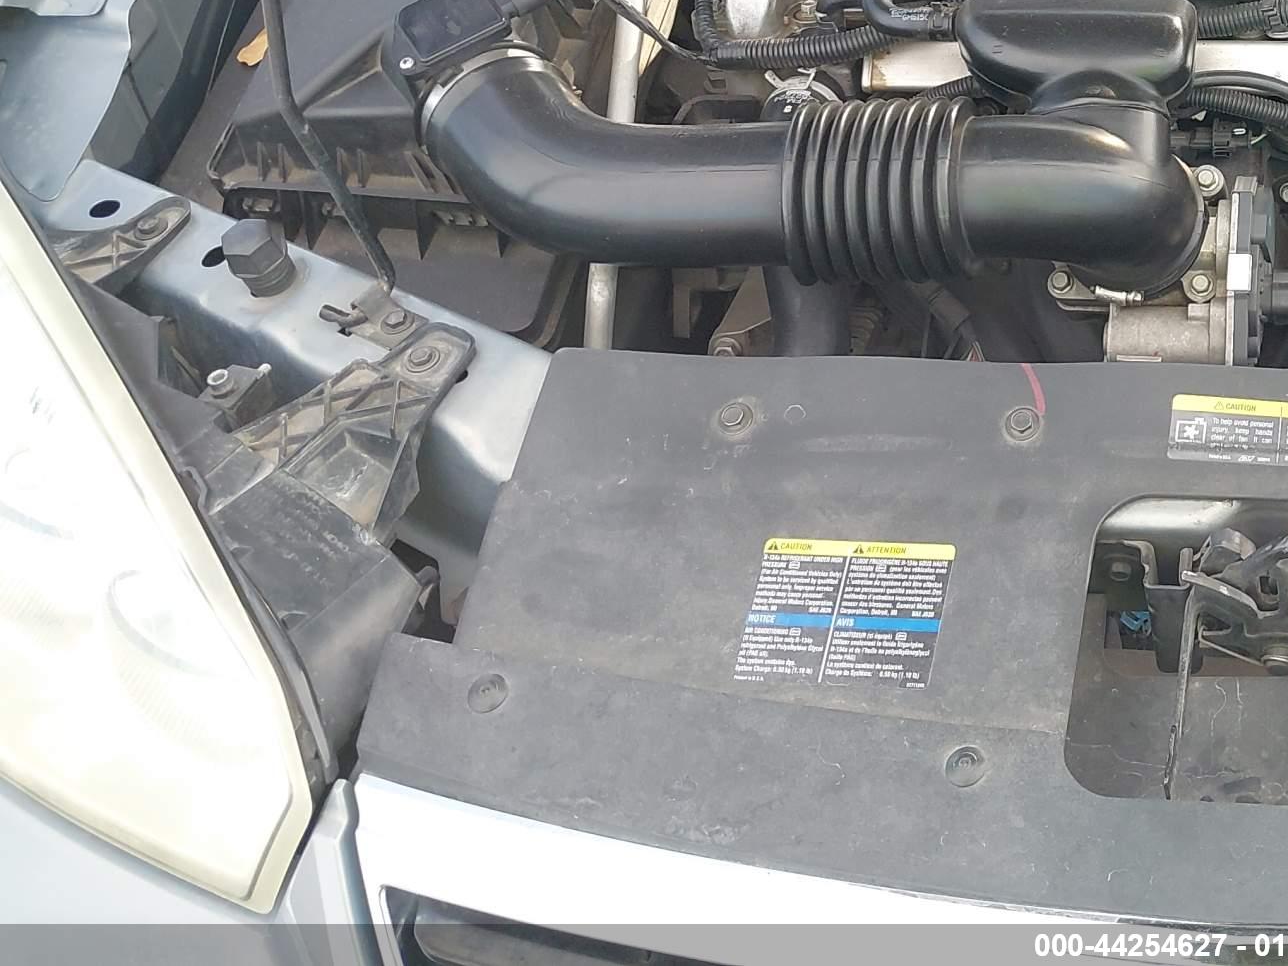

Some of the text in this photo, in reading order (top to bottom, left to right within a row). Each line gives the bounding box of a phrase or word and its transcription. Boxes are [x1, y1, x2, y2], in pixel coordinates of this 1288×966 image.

[1229, 434, 1235, 442] of
[866, 546, 906, 554] ATTENTION
[748, 614, 777, 623] NOTICE
[836, 618, 854, 626] AVIS
